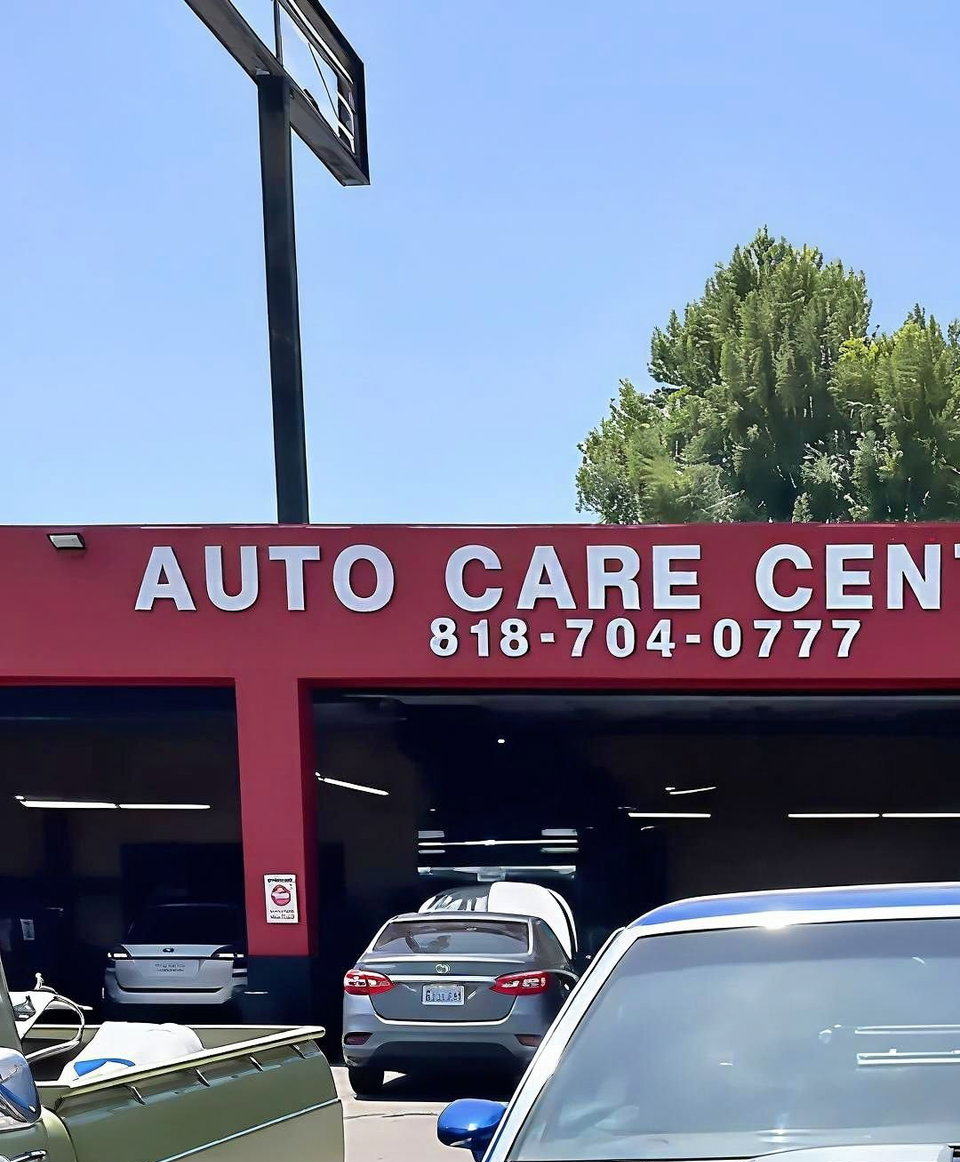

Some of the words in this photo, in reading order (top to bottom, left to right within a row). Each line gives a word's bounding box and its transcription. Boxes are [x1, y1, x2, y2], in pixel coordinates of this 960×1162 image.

[134, 543, 395, 612] AUTO
[444, 543, 701, 612] CARE
[429, 617, 862, 659] 818-704-0777
